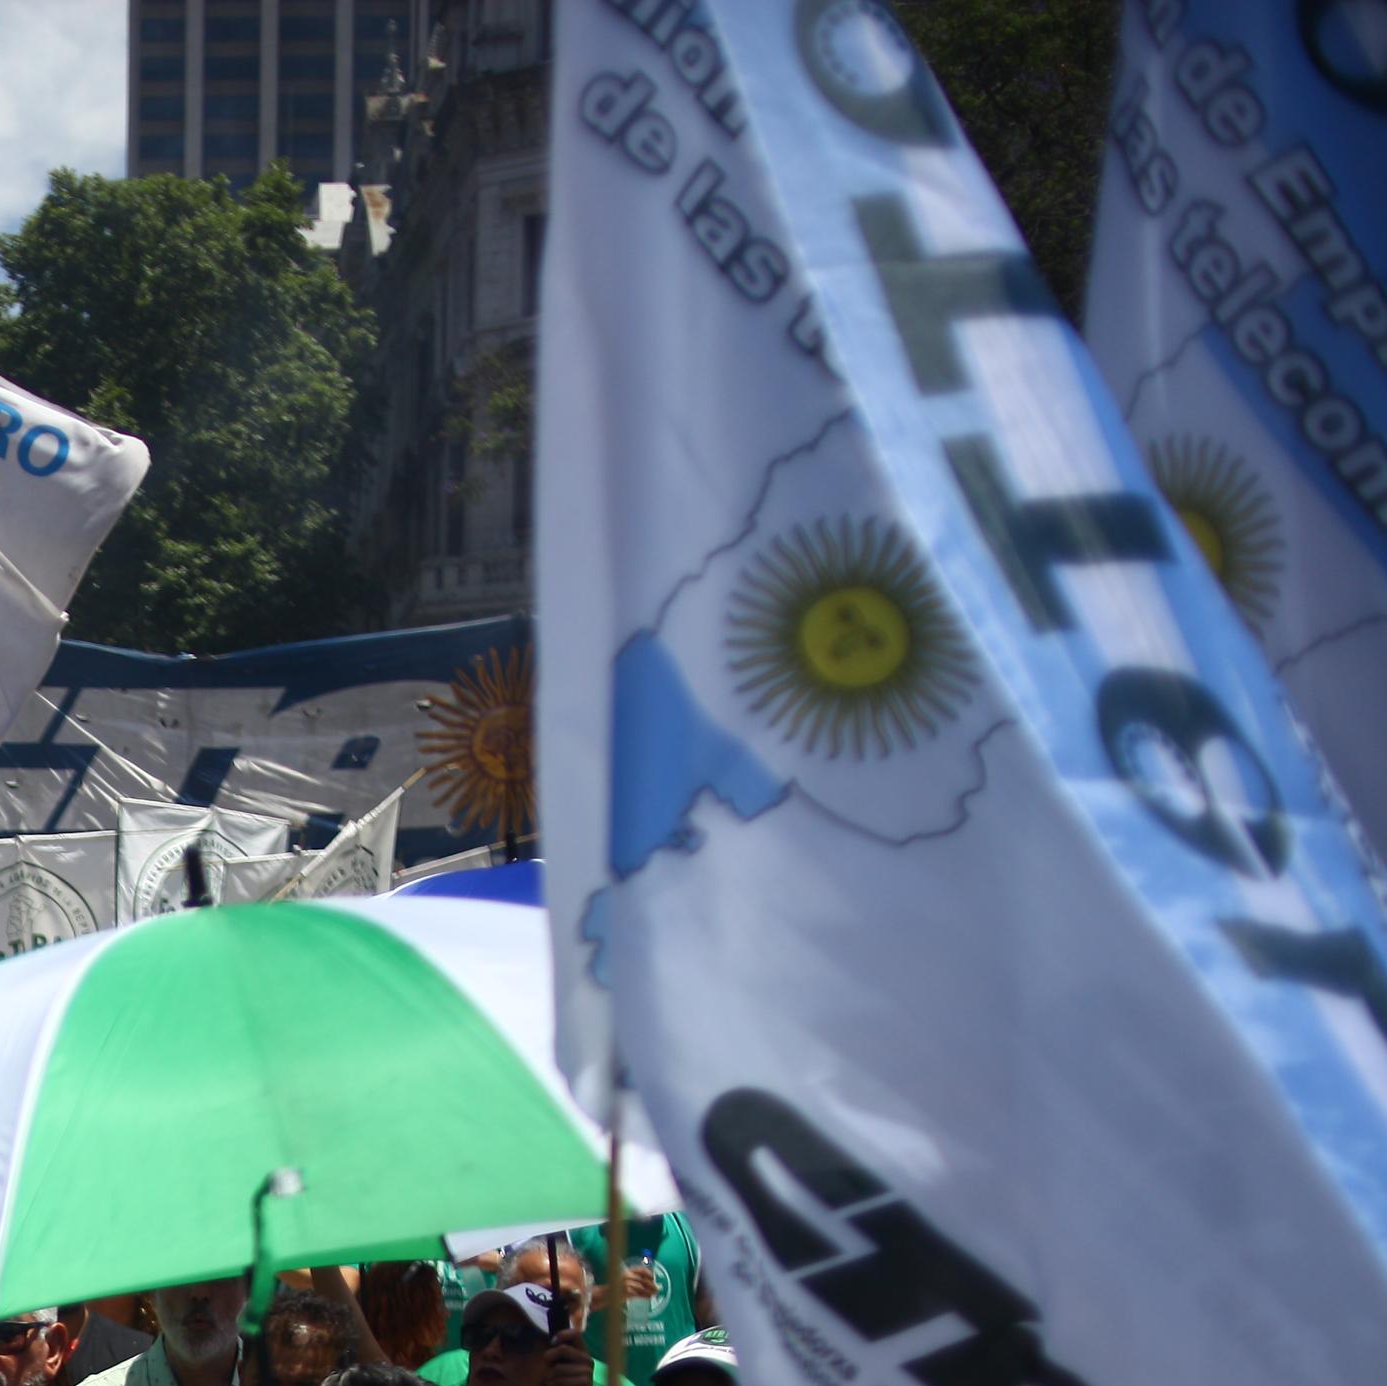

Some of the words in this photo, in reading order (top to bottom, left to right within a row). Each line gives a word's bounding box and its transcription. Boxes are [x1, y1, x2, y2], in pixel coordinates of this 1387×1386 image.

[1176, 37, 1265, 149] de
[579, 70, 676, 176] de
[676, 157, 790, 304] las
